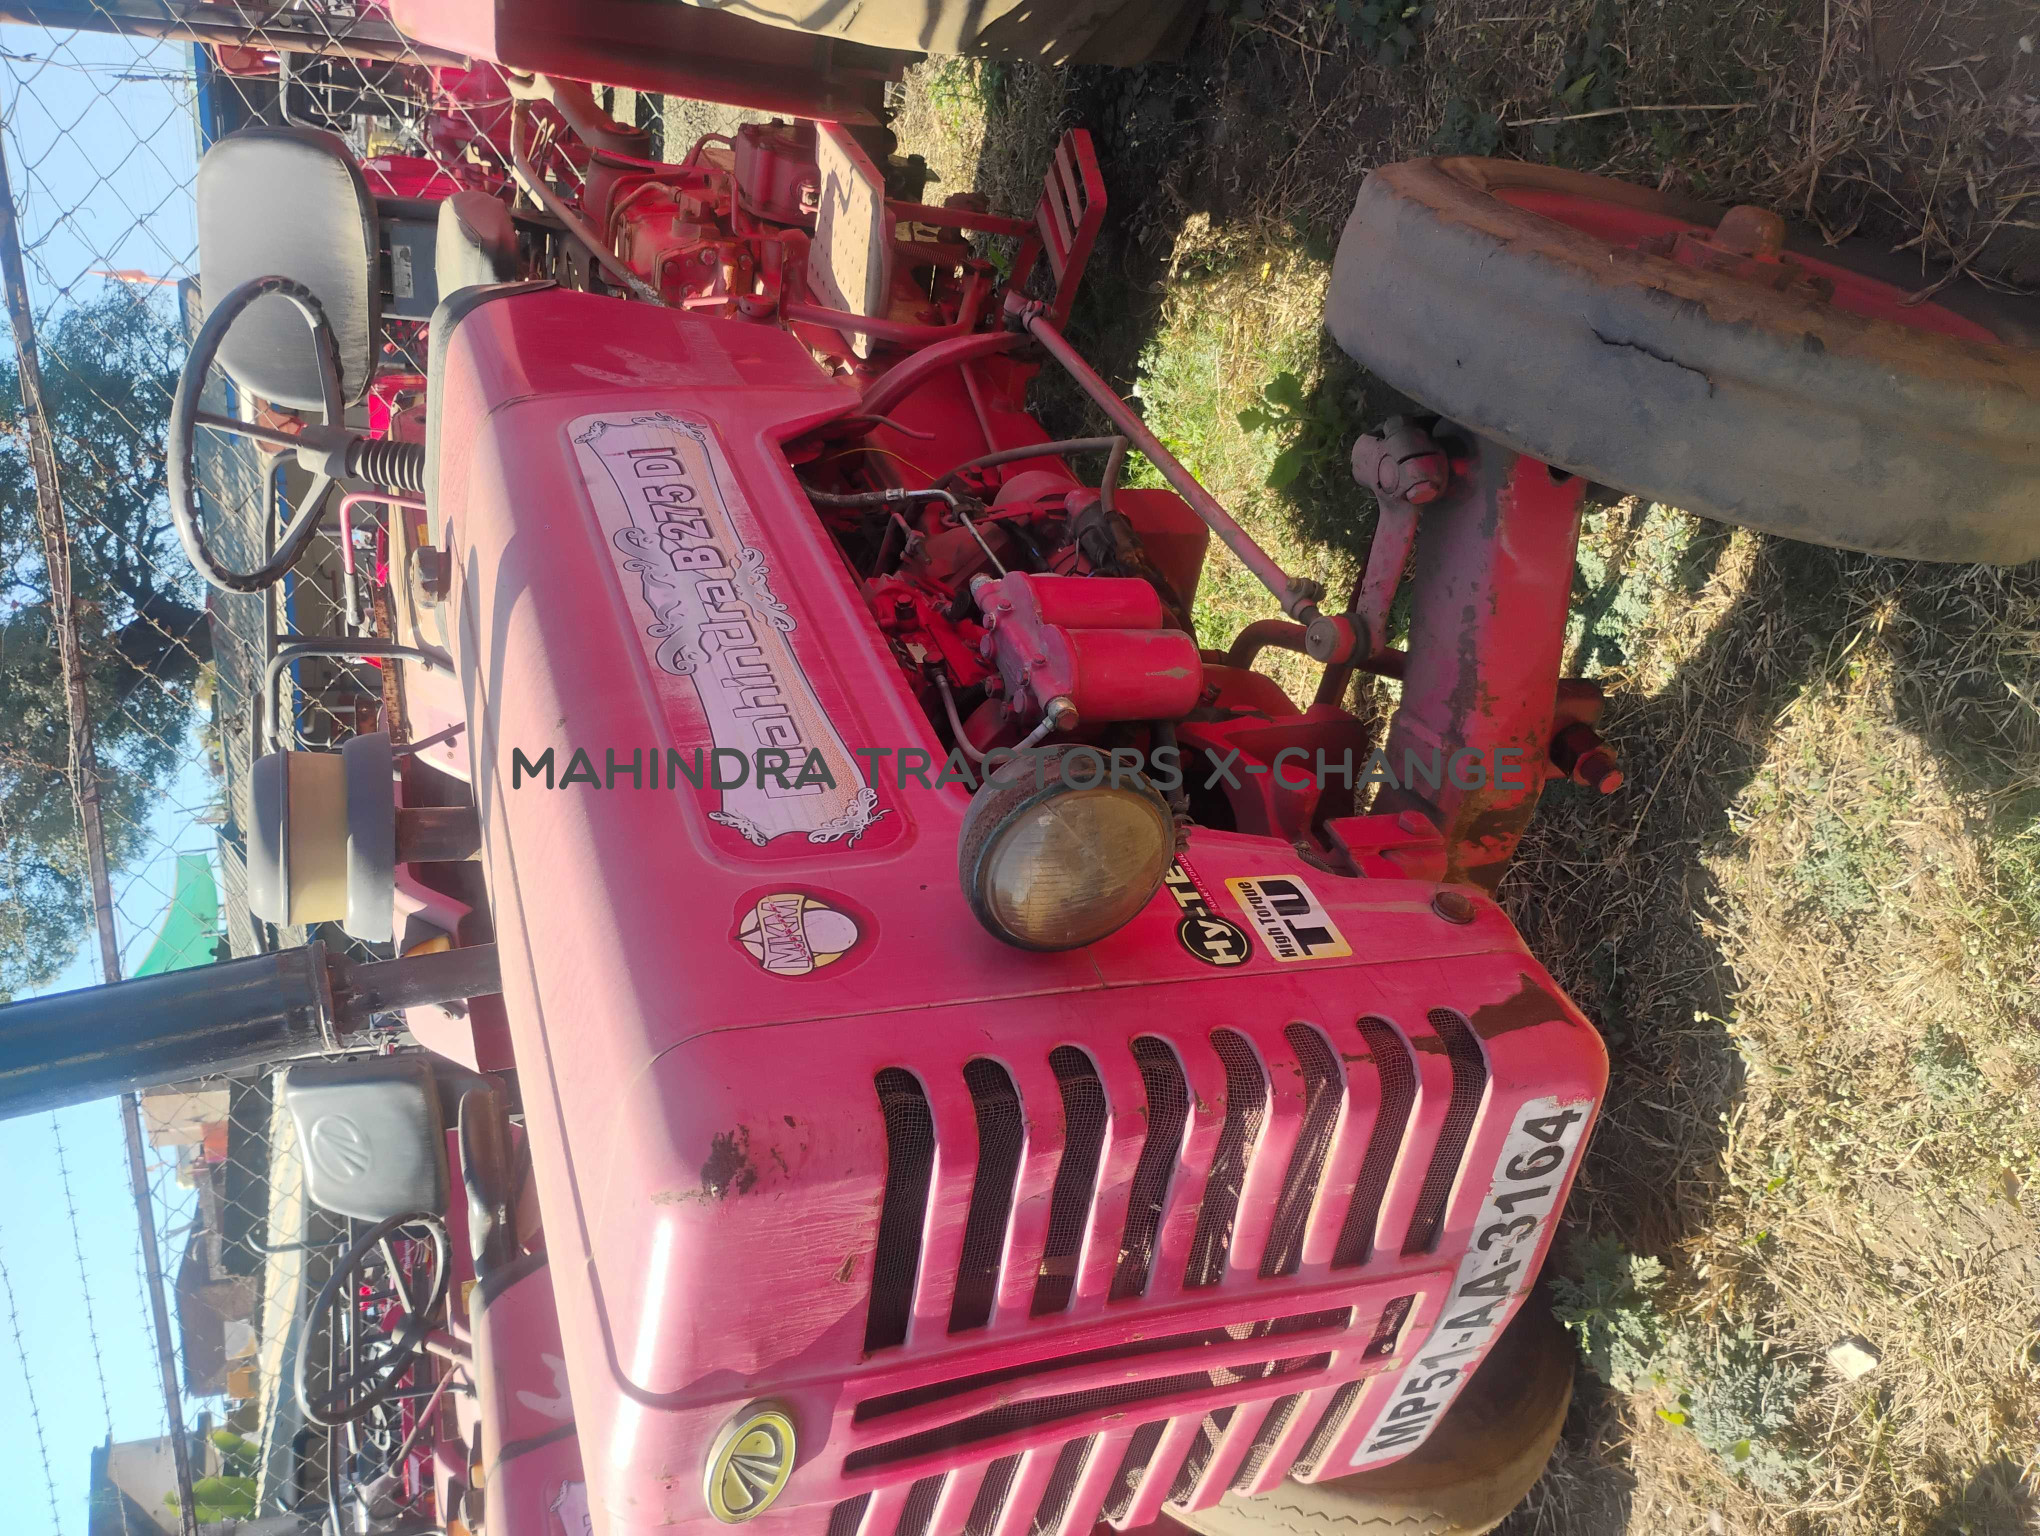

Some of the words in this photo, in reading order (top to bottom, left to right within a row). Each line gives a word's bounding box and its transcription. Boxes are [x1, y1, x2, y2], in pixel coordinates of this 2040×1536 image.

[628, 447, 685, 478] DI
[643, 483, 715, 550] 275
[673, 546, 727, 572] B
[1177, 853, 1203, 886] HYDRAUL
[1164, 865, 1242, 965] Hy-TE
[1238, 881, 1277, 925] Torque
[1257, 879, 1336, 956] TU
[761, 899, 809, 969] MKM
[1267, 926, 1299, 958] High
